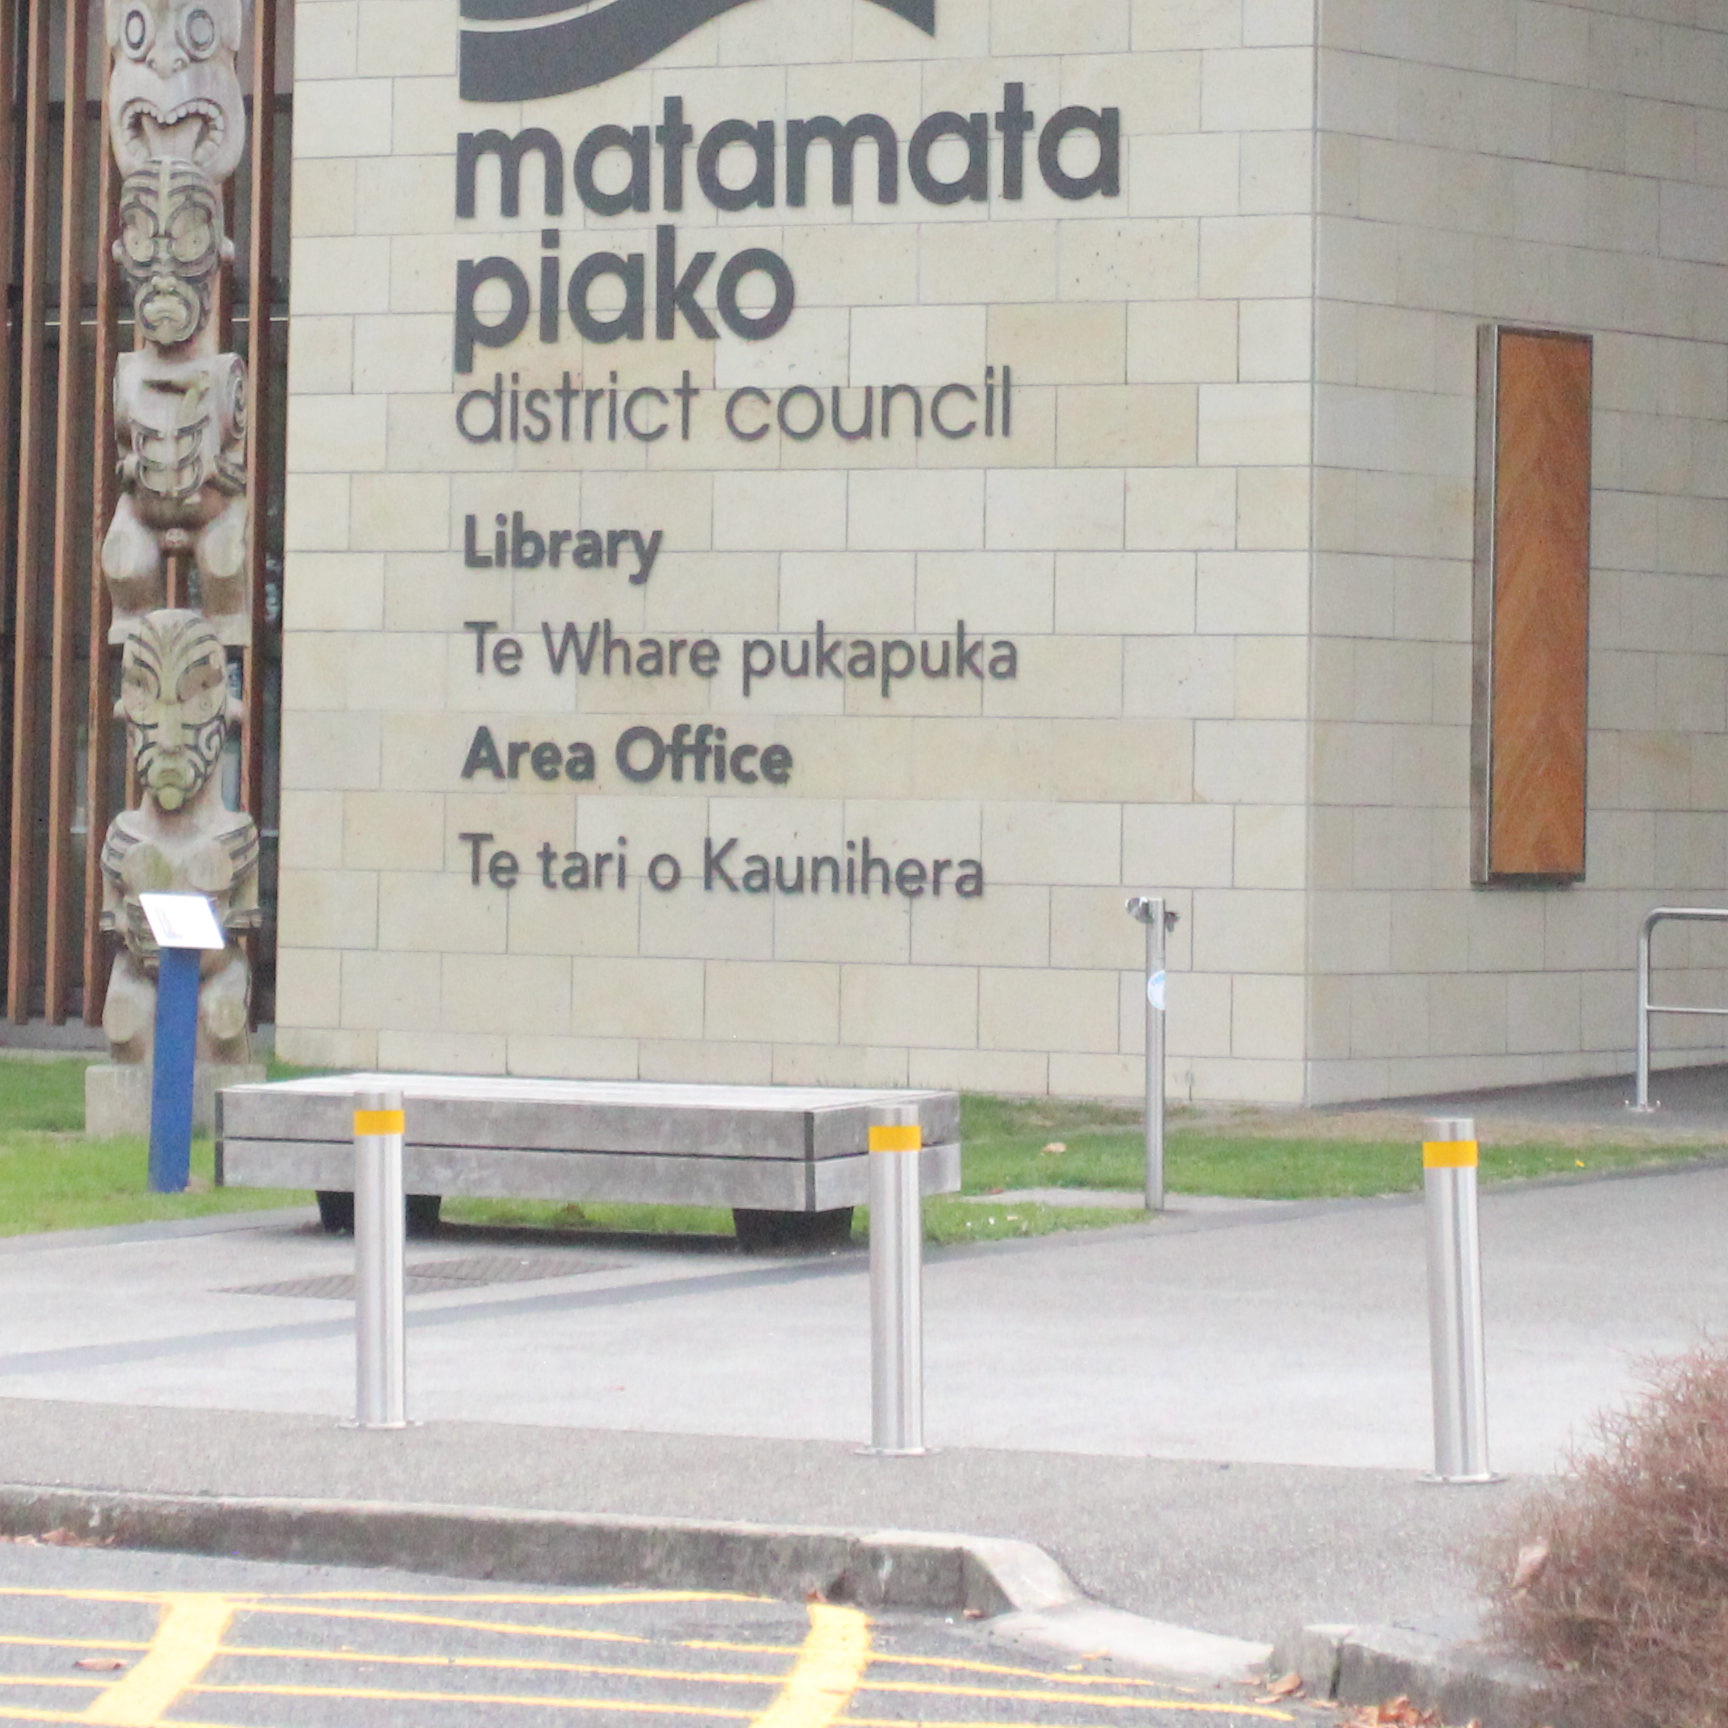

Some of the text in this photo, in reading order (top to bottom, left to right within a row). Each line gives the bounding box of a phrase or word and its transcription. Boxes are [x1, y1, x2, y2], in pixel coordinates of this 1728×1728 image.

[456, 81, 1120, 218] matamata
[455, 225, 795, 373] piako
[456, 366, 1012, 443] district council
[465, 511, 662, 585] Library
[464, 619, 1017, 698] Te Whare pukapuka
[461, 724, 793, 785] Area Office
[459, 833, 984, 900] Te tari o Kaunihera
